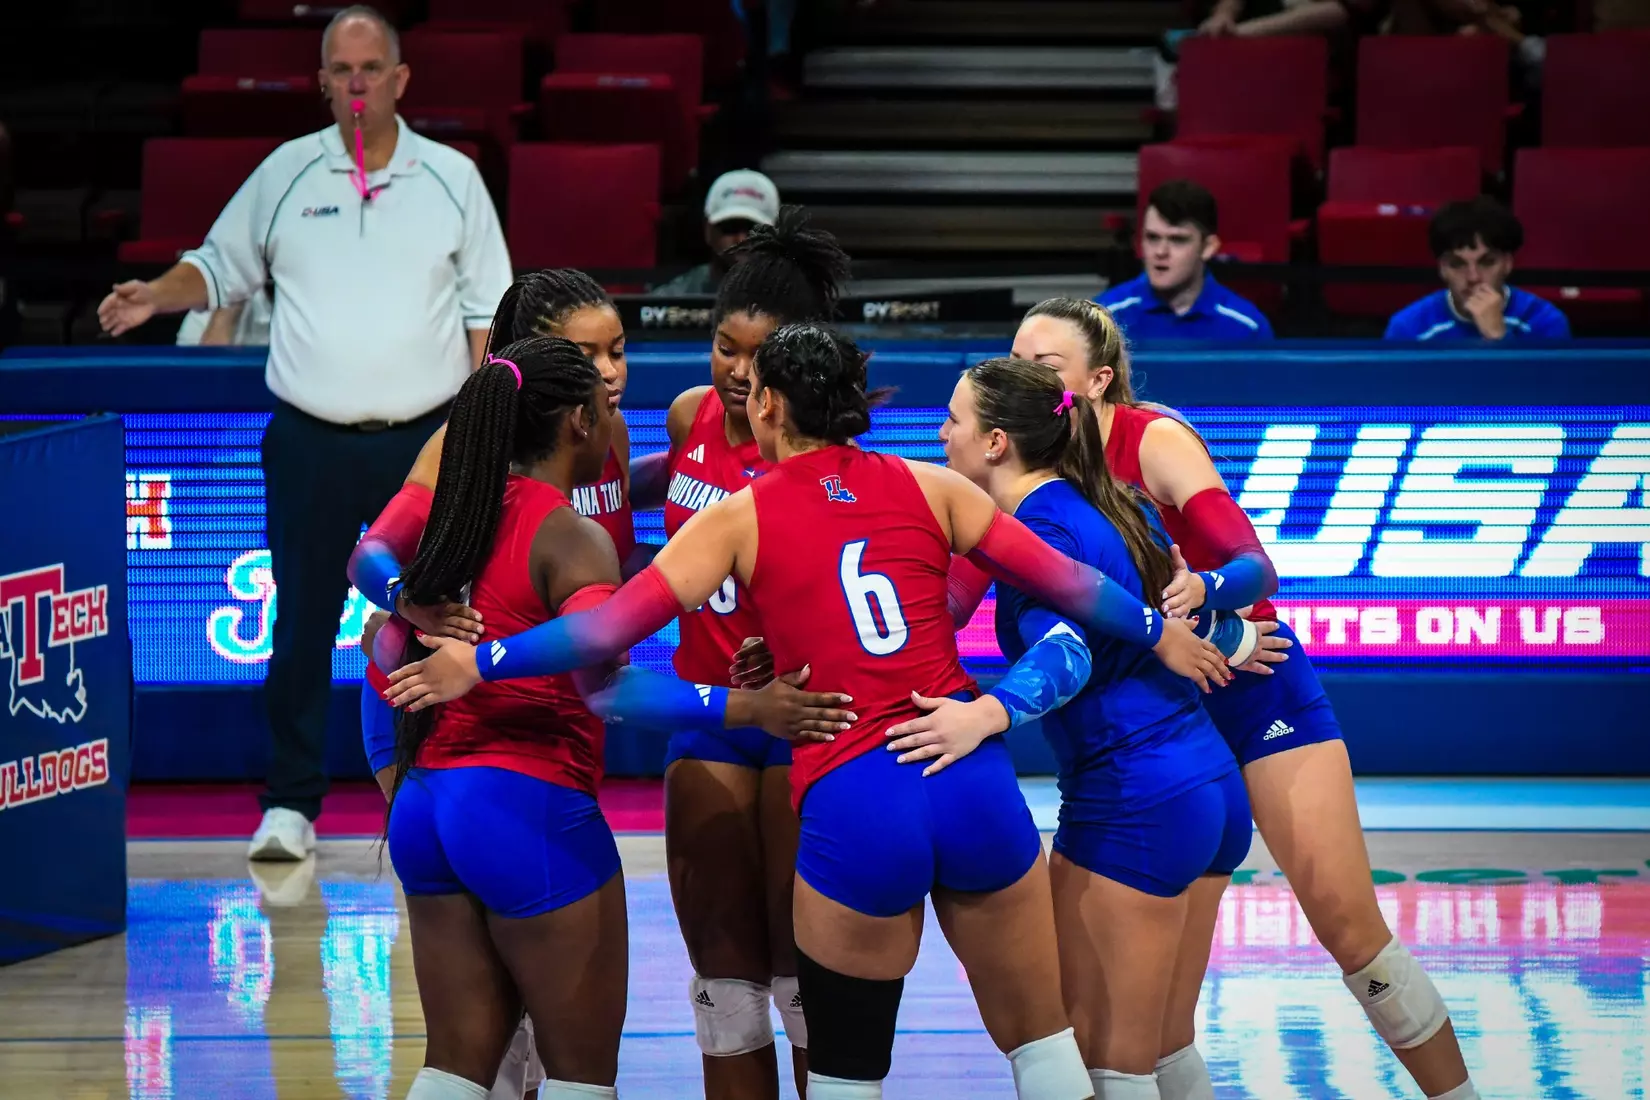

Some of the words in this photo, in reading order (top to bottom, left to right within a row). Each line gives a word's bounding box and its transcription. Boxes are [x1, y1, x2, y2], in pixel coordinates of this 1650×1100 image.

[571, 486, 600, 516] ANA
[1237, 422, 1650, 577] USA
[840, 538, 909, 657] 6
[1275, 606, 1402, 645] ITS
[1416, 606, 1501, 645] ON
[1520, 606, 1604, 645] US
